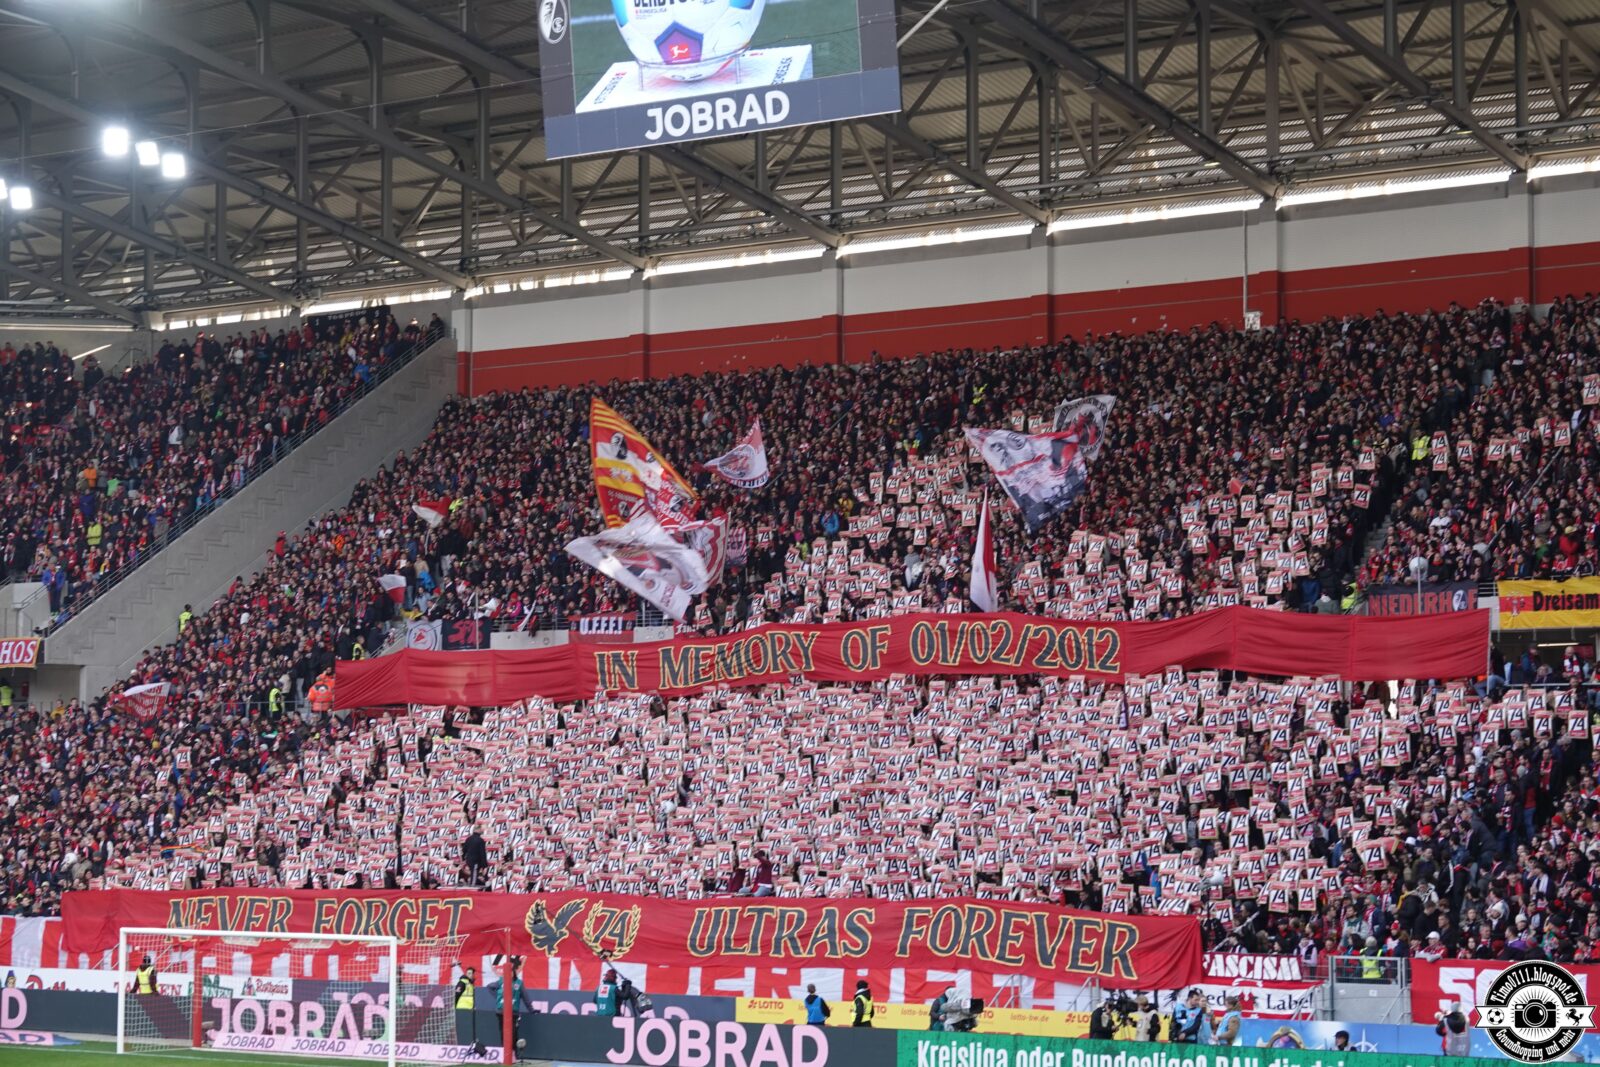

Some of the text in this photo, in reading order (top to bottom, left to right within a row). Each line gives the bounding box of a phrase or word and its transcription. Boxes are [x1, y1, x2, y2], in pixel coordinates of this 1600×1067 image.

[645, 90, 790, 140] JOBRAD
[1532, 590, 1600, 611] Dreisam
[594, 620, 1121, 690] IN MEMORY OF 01/02/2012
[166, 896, 472, 946] NEVER FORGET
[597, 906, 630, 948] 74
[687, 905, 875, 957] ULTRAS
[896, 904, 1140, 980] FOREVER
[206, 998, 390, 1041] JOBRAD
[758, 1001, 784, 1010] LOTTO
[1266, 993, 1314, 1010] Label
[222, 1034, 276, 1049] JOBRAD
[291, 1037, 346, 1053] JOBRAD
[606, 1017, 829, 1067] JOBRAD
[917, 1039, 1009, 1067] Kreisliga
[1015, 1045, 1065, 1067] oder
